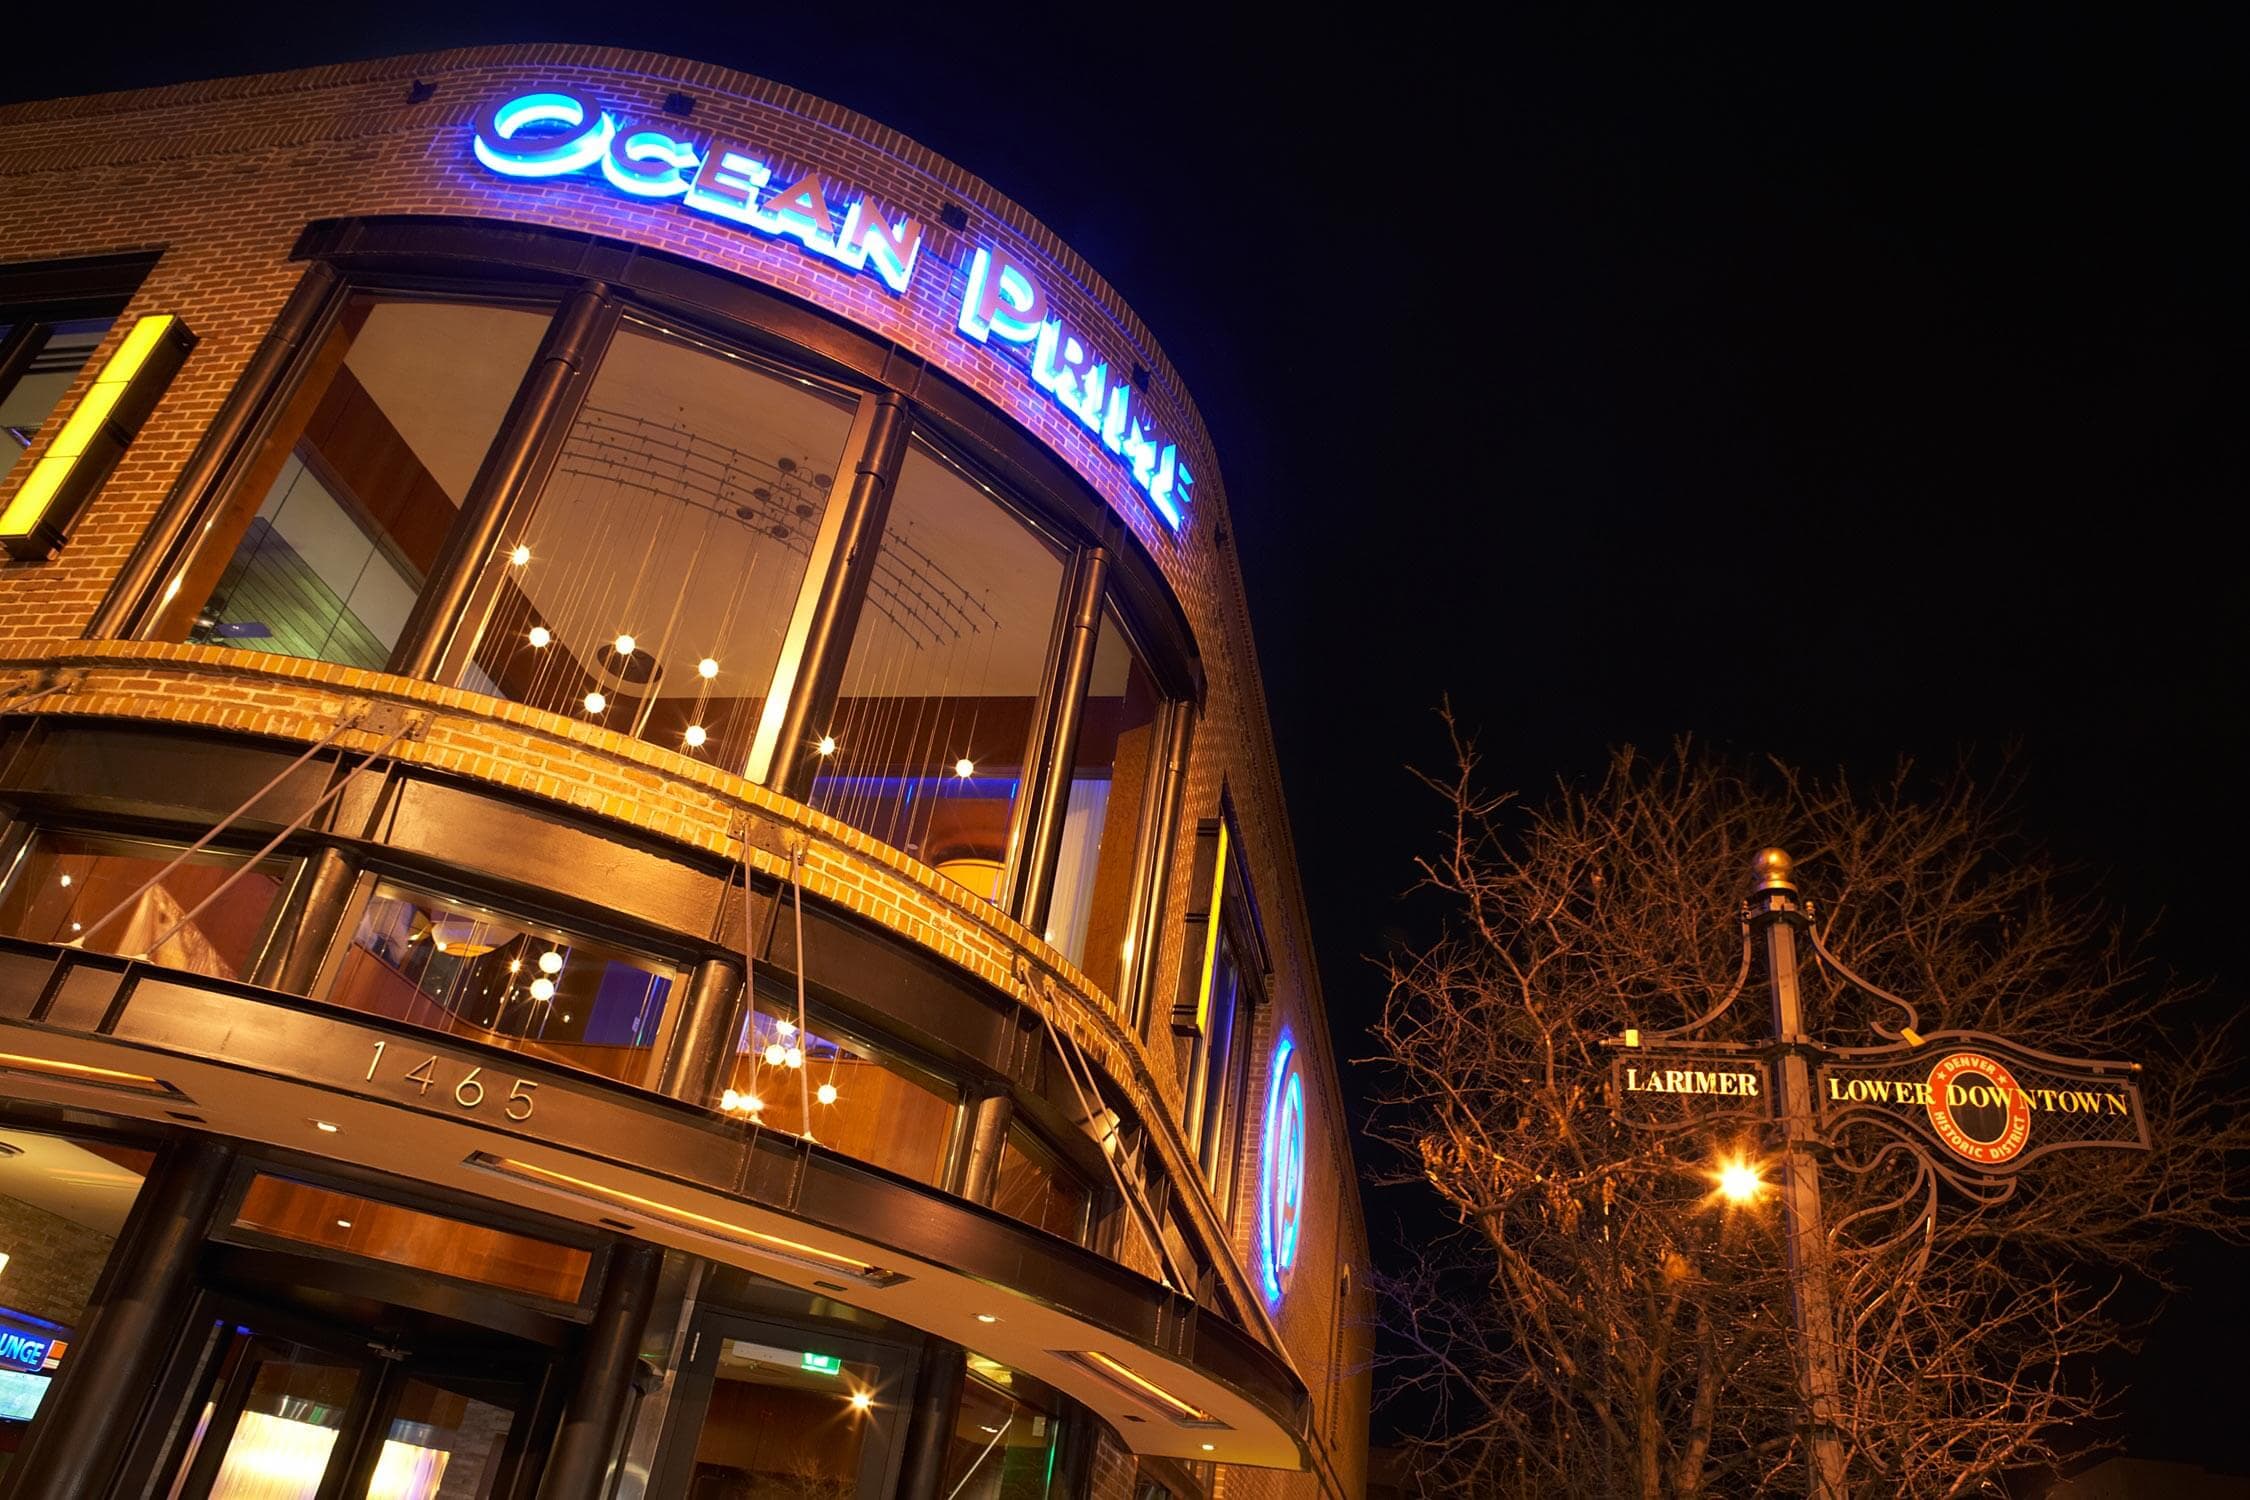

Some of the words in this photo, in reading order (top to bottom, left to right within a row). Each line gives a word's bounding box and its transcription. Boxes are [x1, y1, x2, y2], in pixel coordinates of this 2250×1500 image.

[474, 84, 921, 294] OCEAN
[958, 246, 1195, 532] PRIME
[365, 1040, 539, 1121] 1465
[1626, 1068, 1760, 1097] LARIMER
[1944, 1057, 1997, 1075] DENVER
[1828, 1078, 1936, 1104] LOWER
[1946, 1084, 2128, 1116] DOWNTOWN
[1934, 1111, 1984, 1158] HISTORIC
[1989, 1115, 2026, 1160] DISTRICT
